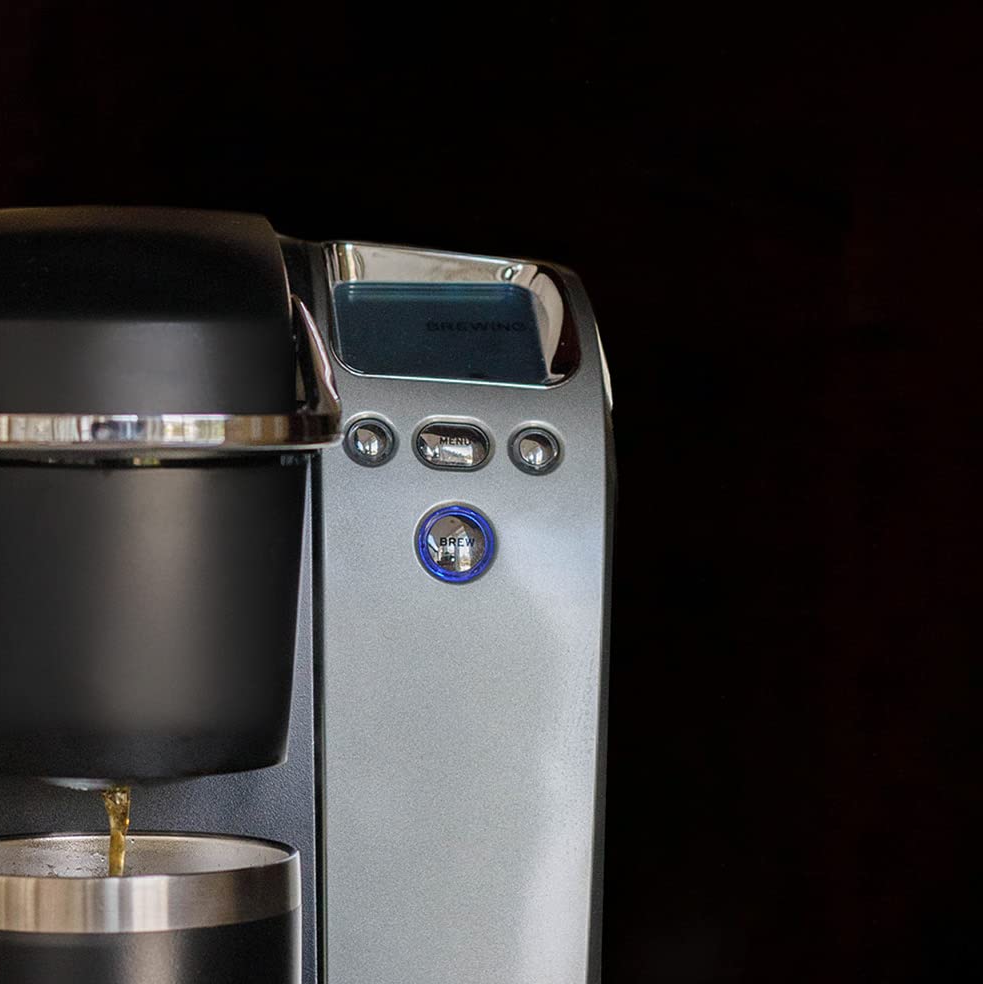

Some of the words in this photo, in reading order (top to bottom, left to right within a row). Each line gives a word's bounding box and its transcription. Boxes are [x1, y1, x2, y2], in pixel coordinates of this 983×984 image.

[426, 320, 527, 332] BREWING
[440, 437, 472, 445] MENU
[440, 537, 475, 547] BREW
